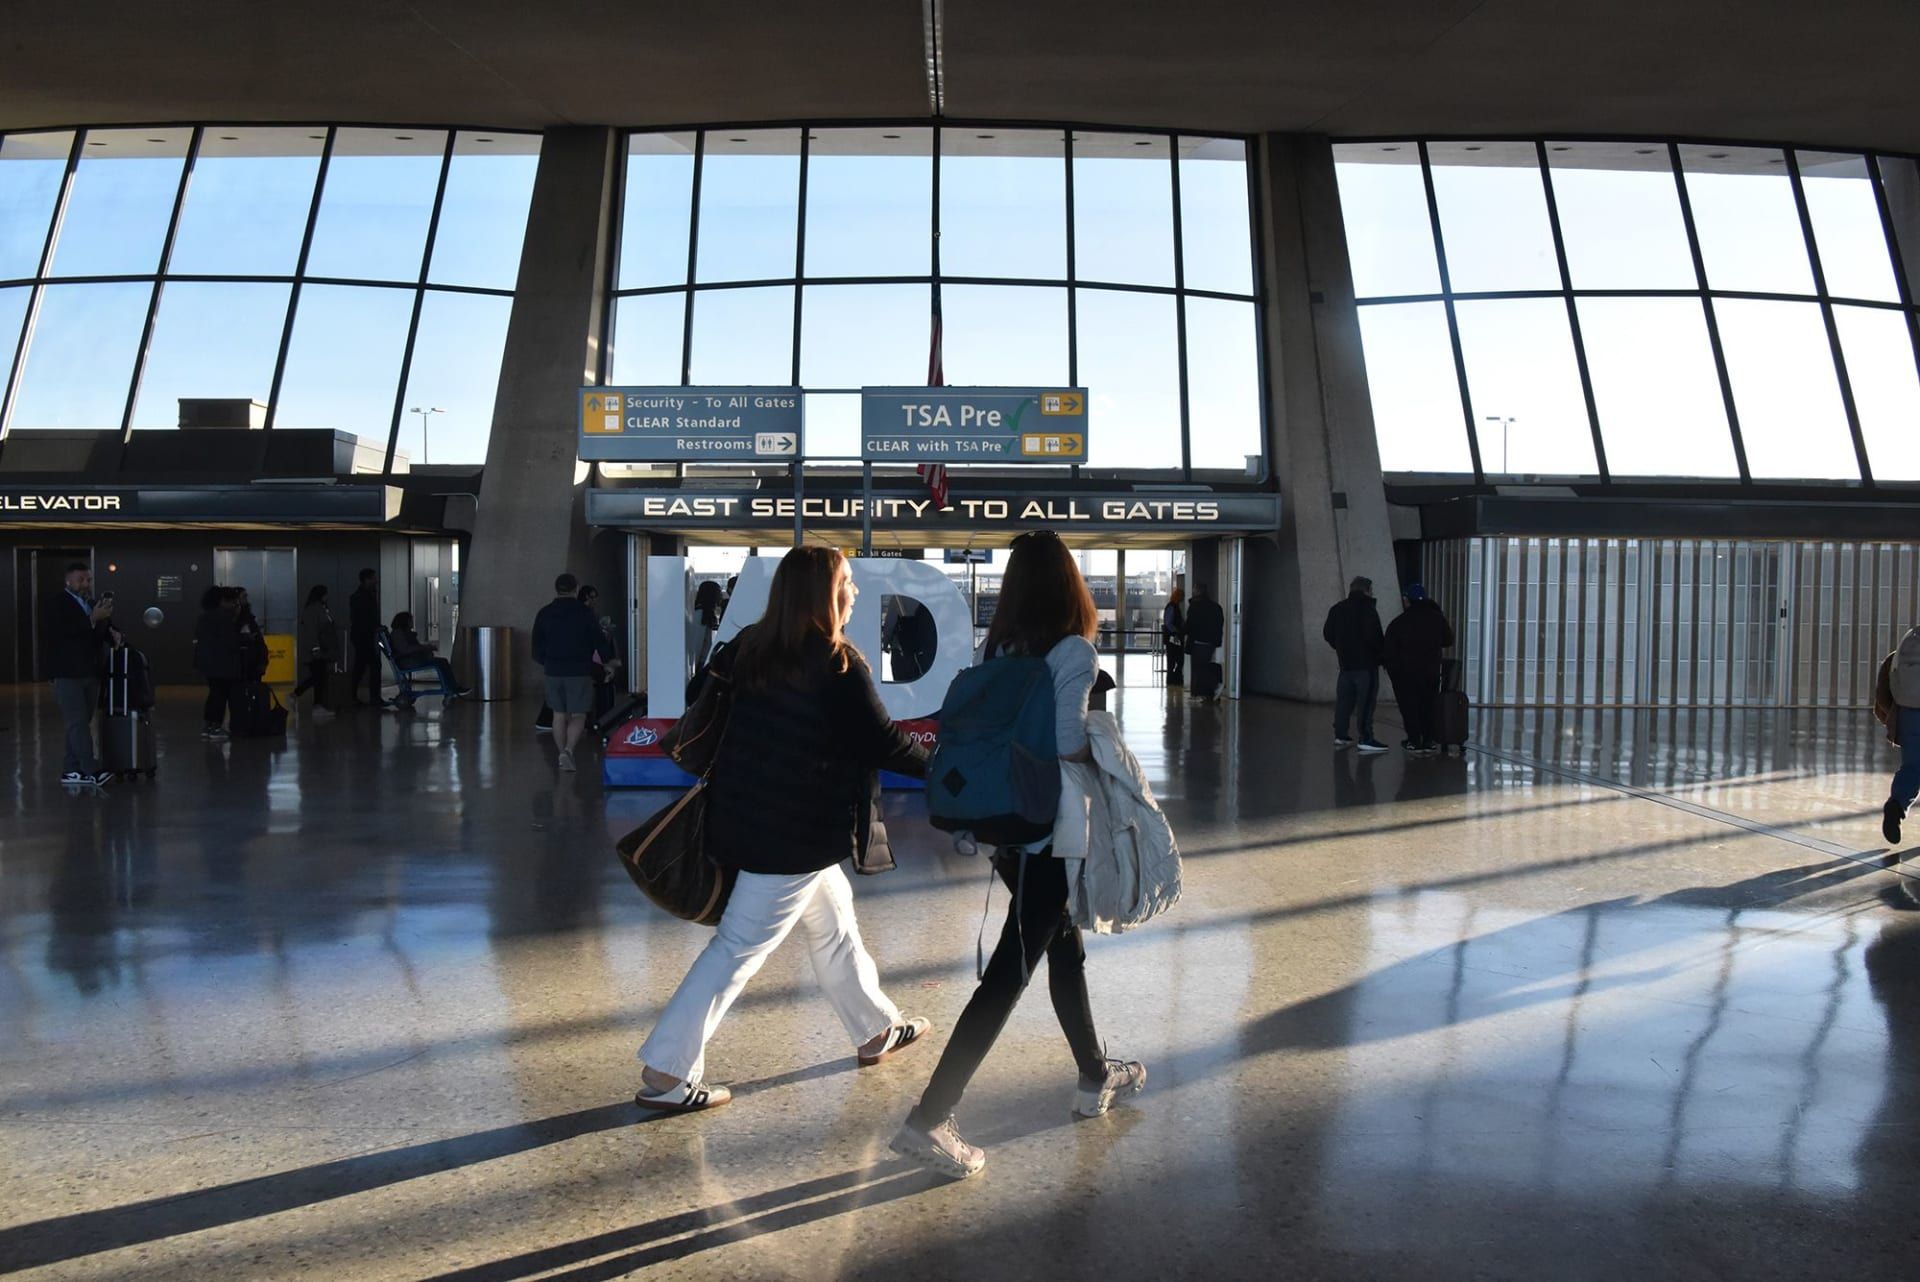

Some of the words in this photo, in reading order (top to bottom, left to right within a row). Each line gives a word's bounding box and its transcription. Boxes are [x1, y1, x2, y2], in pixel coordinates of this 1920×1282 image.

[627, 396, 684, 411] Security
[705, 397, 722, 408] To
[728, 396, 748, 408] All
[754, 397, 795, 408] Gates
[627, 416, 670, 428] CLEAR
[676, 416, 741, 428] Standard
[901, 404, 953, 427] TSA
[960, 405, 1002, 427] Pre
[676, 438, 752, 450] Restrooms
[866, 440, 910, 452] CLEAR
[916, 439, 949, 452] with
[955, 441, 979, 452] TSA
[982, 441, 1002, 452] Pre
[0, 495, 121, 510] LEVATOR
[643, 497, 739, 516] EAST
[751, 498, 931, 518] SECURITY
[960, 500, 1008, 519] TO
[1020, 501, 1091, 520] ALL
[1102, 501, 1219, 520] GATES
